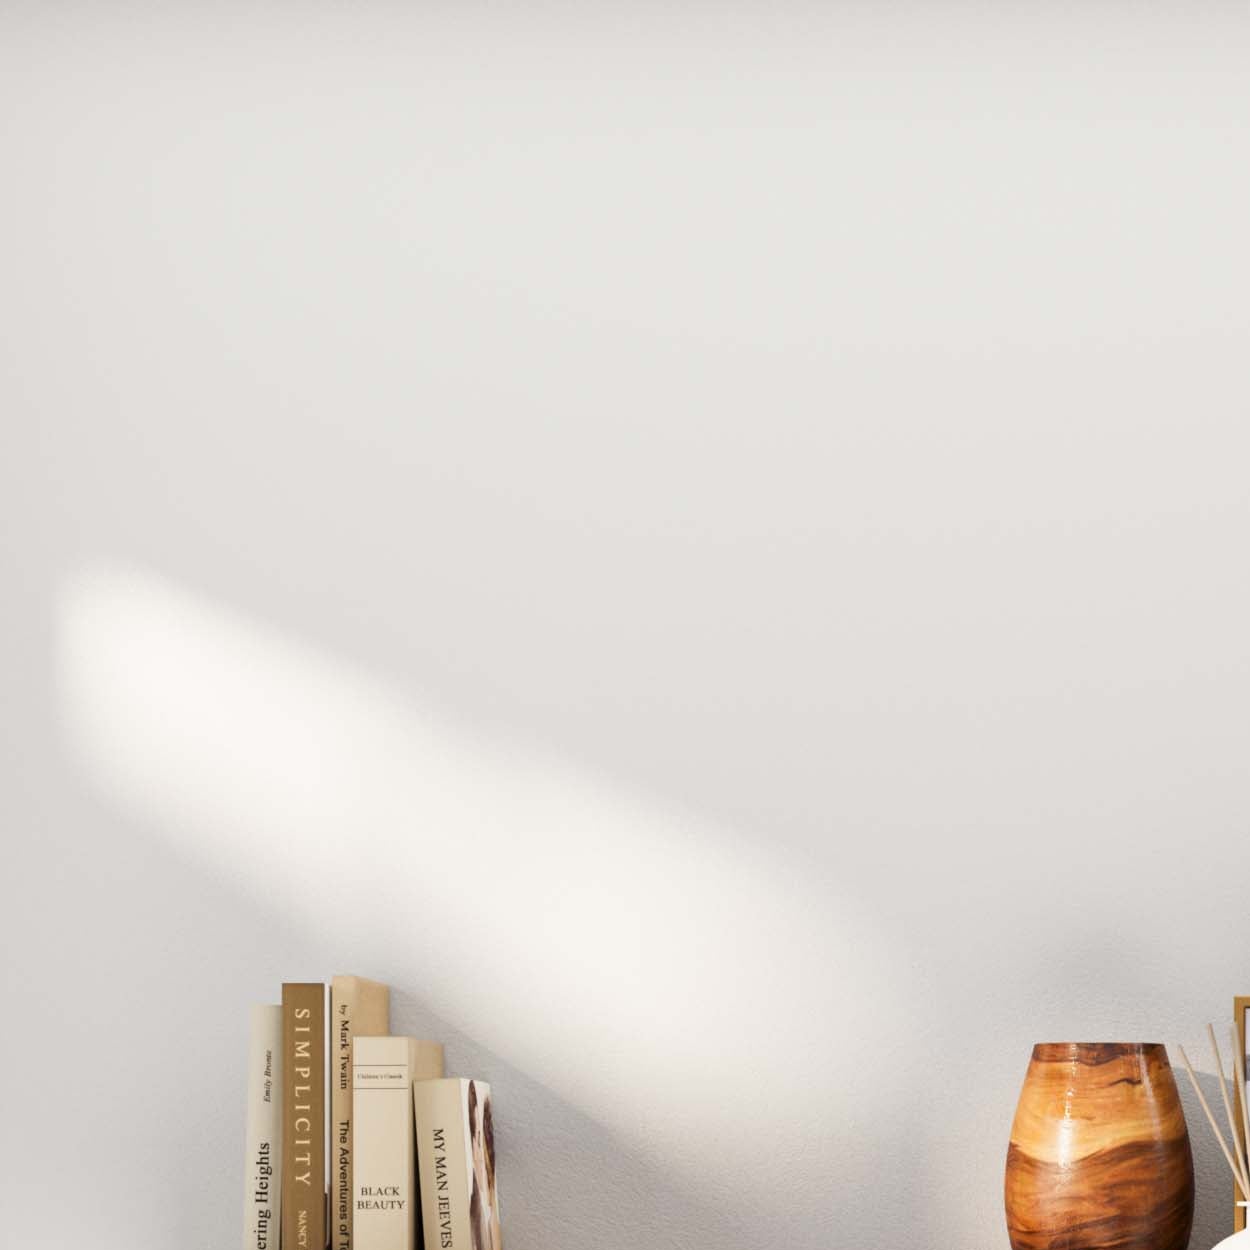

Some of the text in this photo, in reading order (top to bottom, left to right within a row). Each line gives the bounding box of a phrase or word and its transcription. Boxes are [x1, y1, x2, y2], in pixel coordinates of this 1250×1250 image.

[340, 1020, 350, 1051] Mark
[340, 1054, 350, 1090] Twain
[263, 1080, 273, 1103] Emily
[294, 1008, 311, 1186] SIMPLICITY
[339, 1120, 350, 1144] The
[255, 1142, 273, 1204] Heights
[339, 1147, 350, 1220] Adventures
[432, 1128, 453, 1249] MY MAN JEEVES
[357, 1200, 406, 1210] BEAUTY
[361, 1186, 400, 1196] BLACK
[298, 1210, 307, 1247] NANCY
[339, 1224, 350, 1236] of
